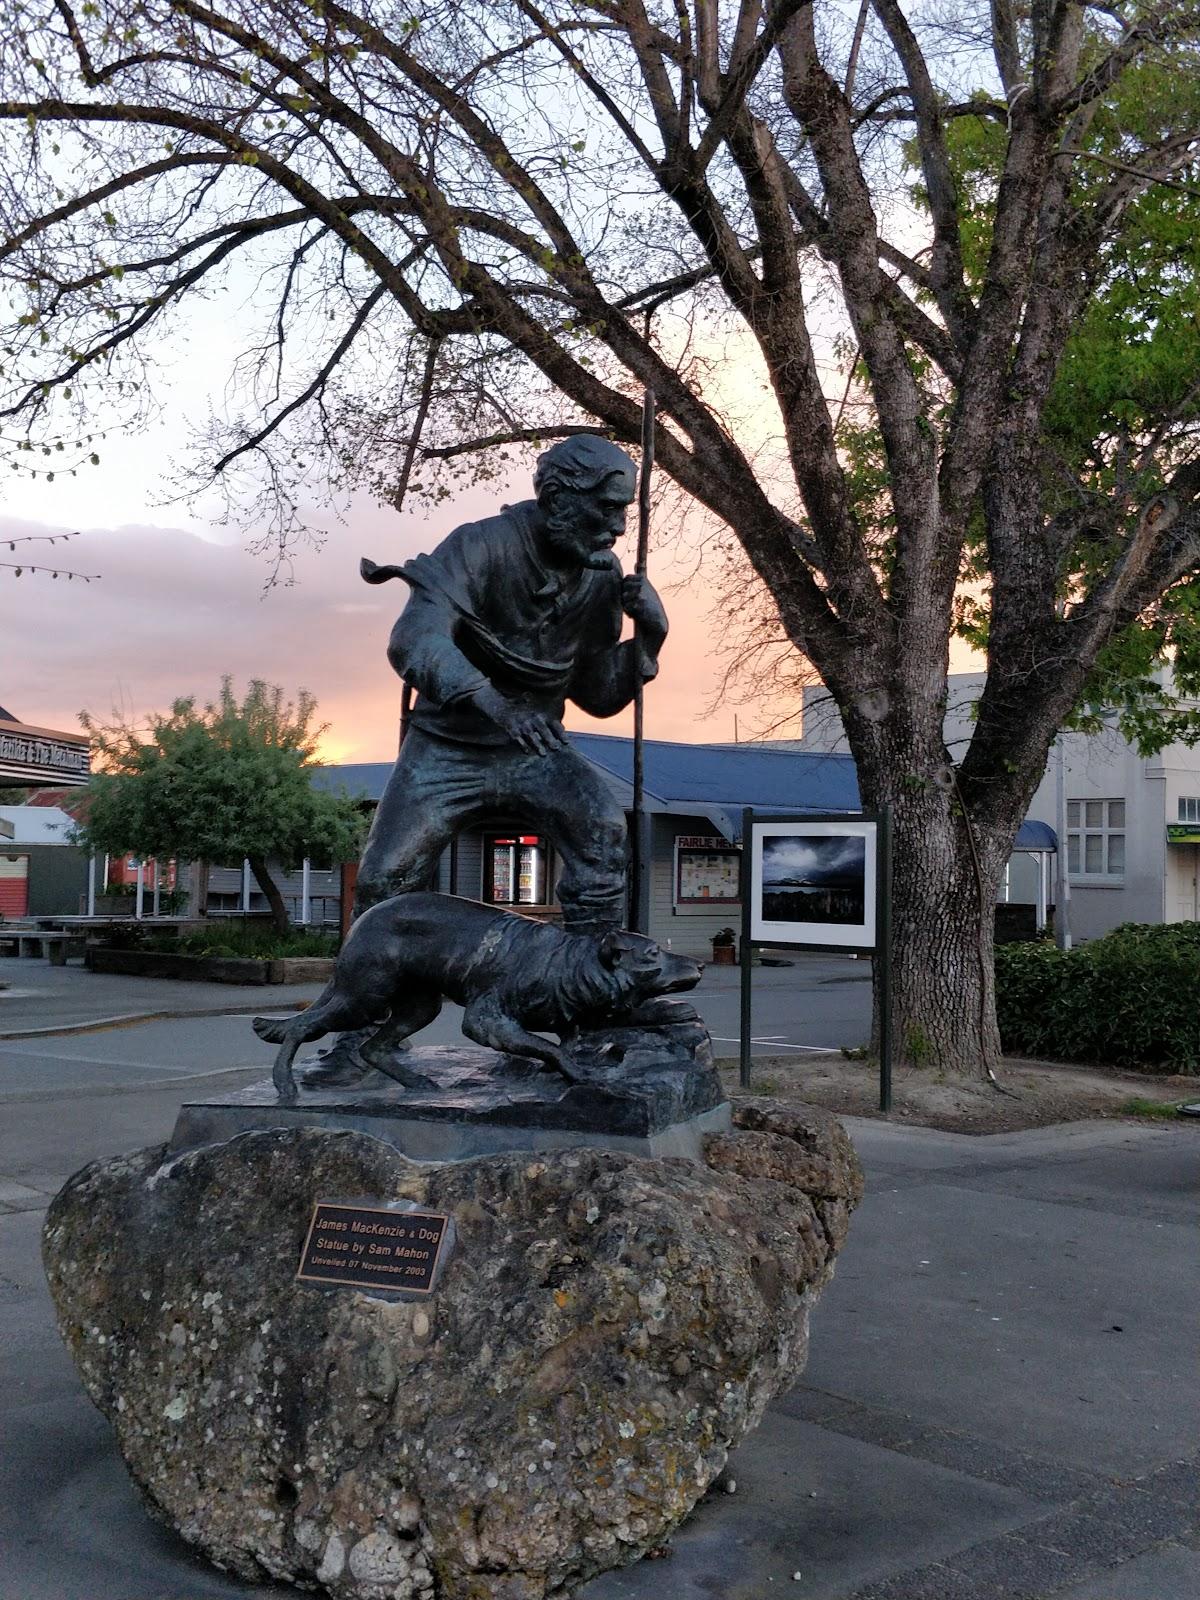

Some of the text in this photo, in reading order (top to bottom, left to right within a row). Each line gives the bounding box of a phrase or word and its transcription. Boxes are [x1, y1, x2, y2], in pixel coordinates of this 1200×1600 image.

[679, 837, 713, 848] FAIRLIE
[316, 1218, 440, 1243] James MacKenzie & Dog
[317, 1238, 429, 1259] Statue by Sam Mahon
[312, 1256, 426, 1276] Unveiled 07 November 2003
